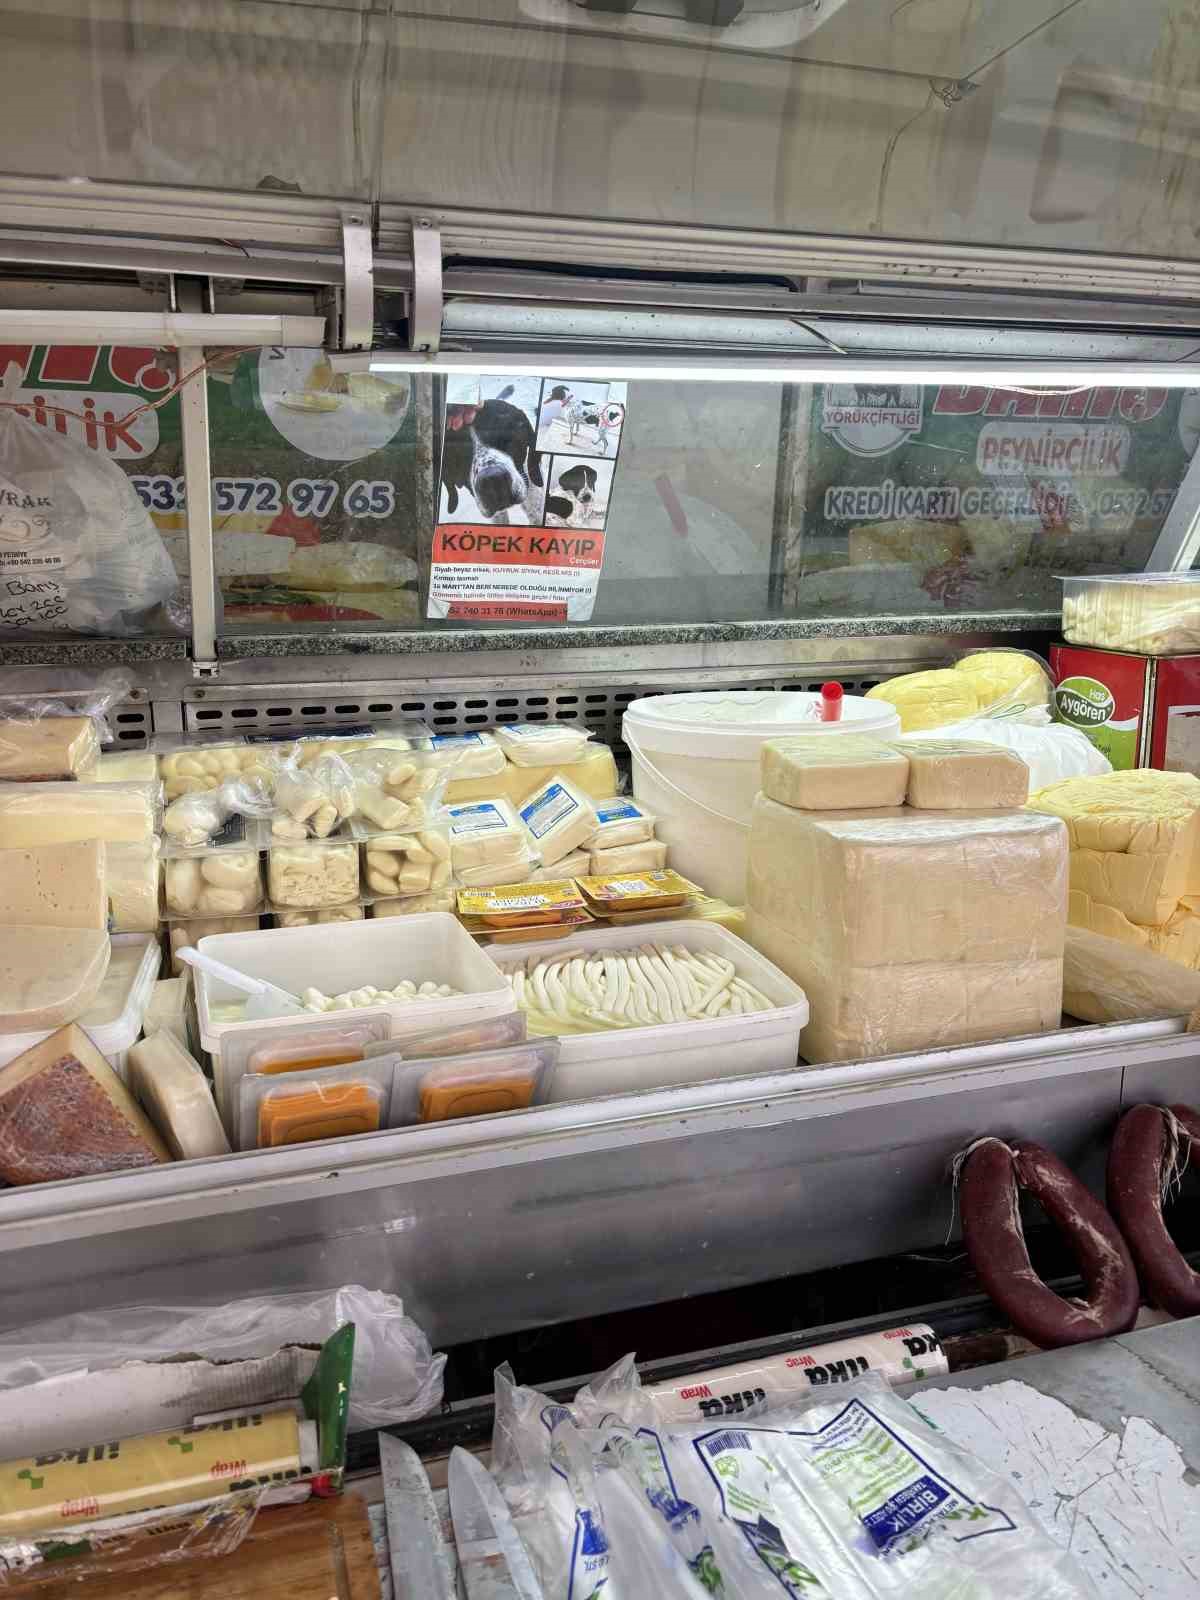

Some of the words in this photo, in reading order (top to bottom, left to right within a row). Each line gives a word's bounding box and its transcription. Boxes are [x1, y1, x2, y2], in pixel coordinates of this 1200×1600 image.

[825, 409, 920, 427] YÖRÜKÇİFTLİĞİ
[983, 428, 1121, 470] PEYNİRCİLİK
[215, 482, 278, 511] 572
[292, 482, 334, 513] 97
[348, 484, 391, 514] 65
[828, 481, 891, 514] KREDİ
[896, 490, 955, 515] KARTI
[441, 530, 523, 553] KÖPEK
[529, 536, 595, 556] KAYIP
[1061, 694, 1106, 720] Aygören
[1089, 689, 1105, 700] Has
[680, 1384, 713, 1400] Wrap
